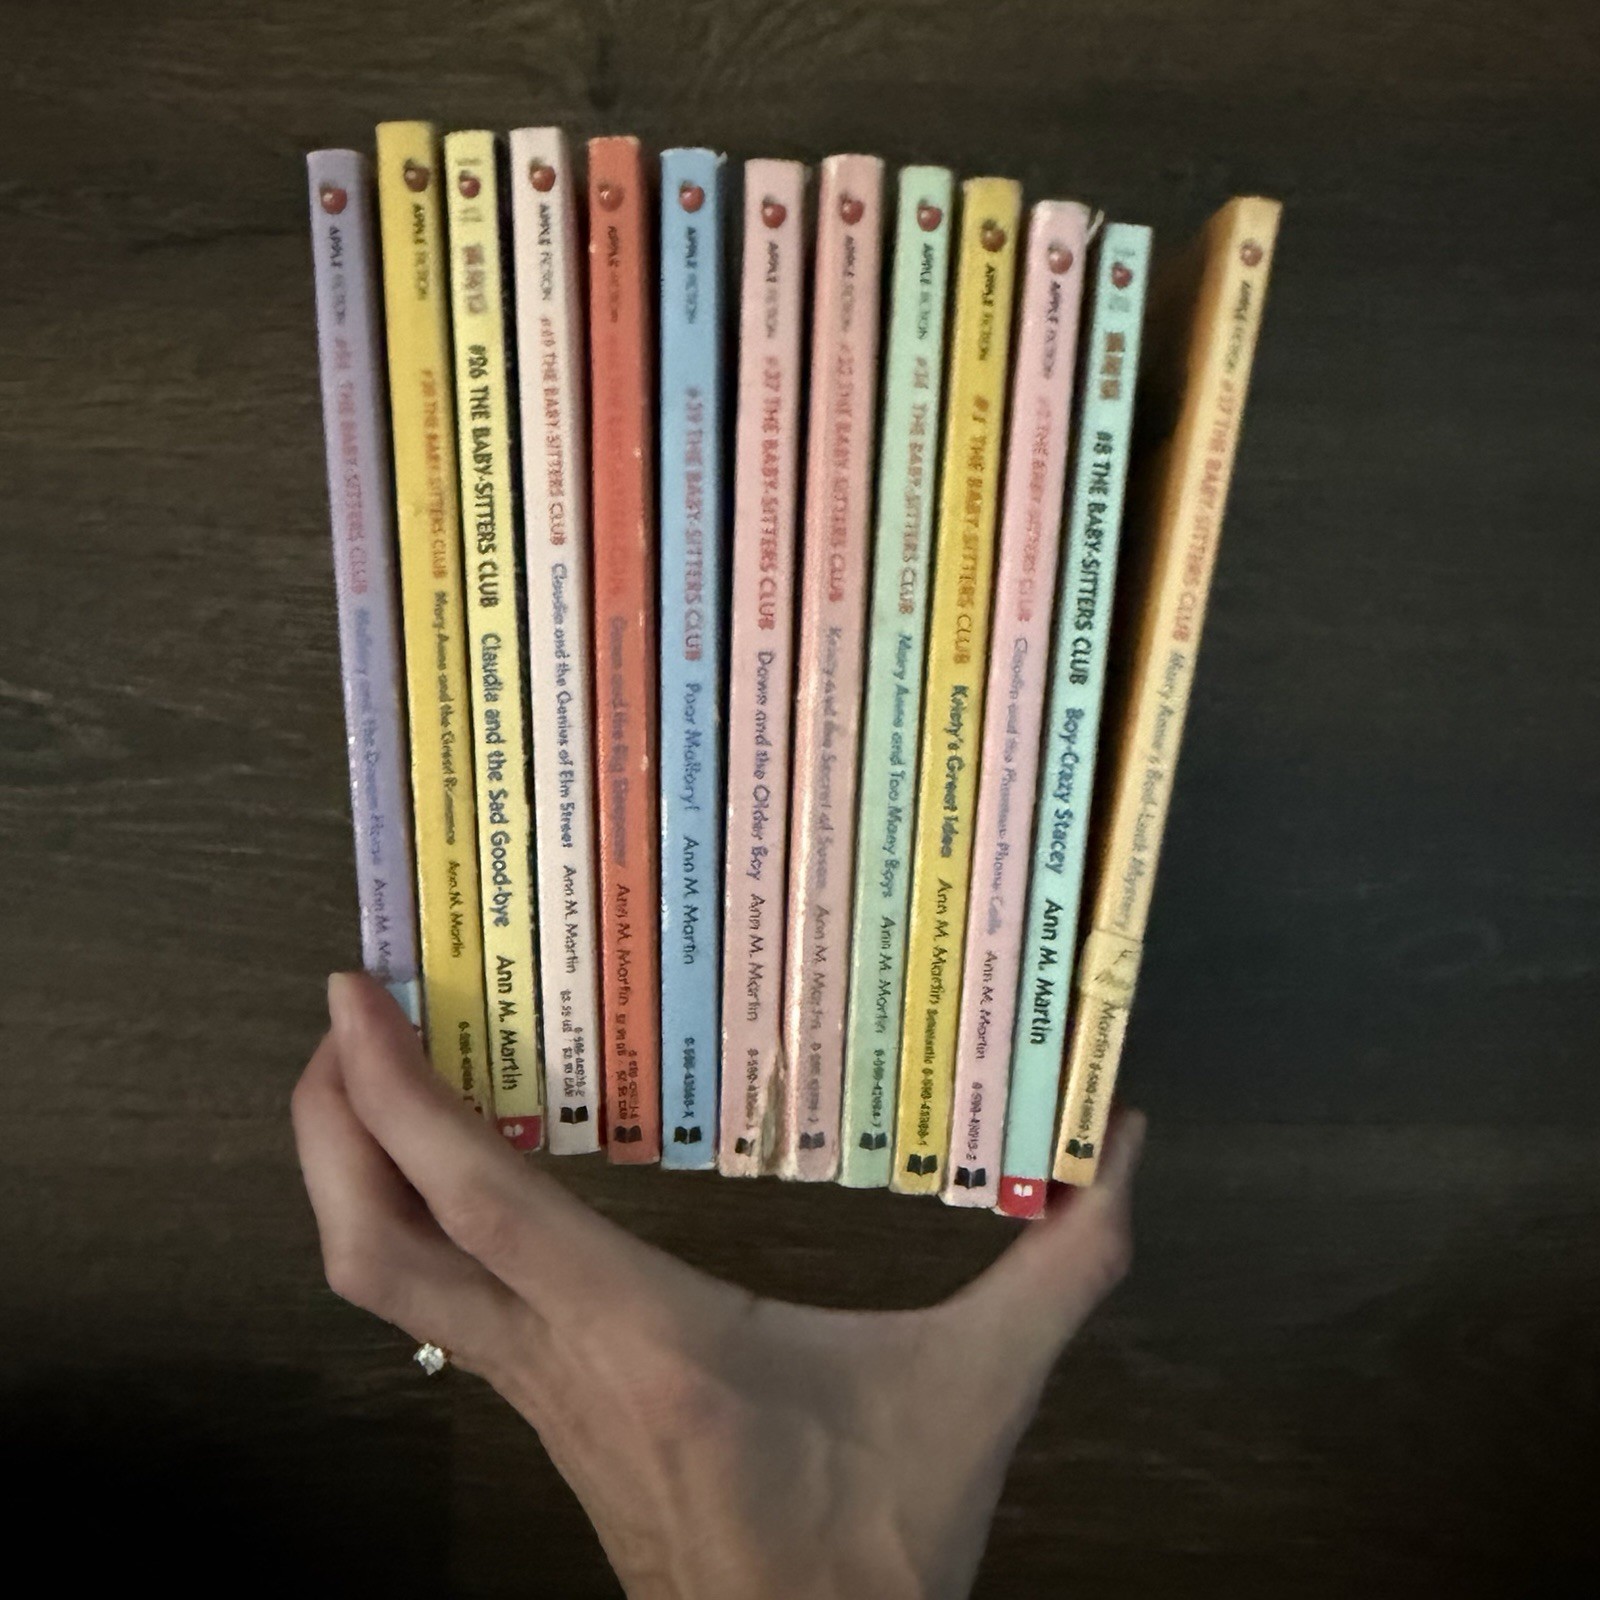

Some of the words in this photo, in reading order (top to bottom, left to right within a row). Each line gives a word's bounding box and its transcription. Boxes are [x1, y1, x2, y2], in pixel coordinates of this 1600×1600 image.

[980, 262, 997, 307] APPLE
[541, 352, 557, 381] THE
[468, 385, 491, 419] THE
[761, 396, 780, 433] THE
[967, 434, 987, 470] THE
[470, 426, 497, 554] BABY-SITTERS
[1087, 459, 1110, 496] THE
[548, 502, 566, 546] CLUB
[476, 559, 499, 608] CLUB
[1073, 500, 1107, 632] BABY-SITTERS
[757, 576, 776, 631] CLUB
[898, 566, 918, 615] CLUB
[554, 628, 570, 659] and
[684, 608, 702, 660] CLUB
[892, 632, 912, 680] Mary
[952, 612, 973, 665] CLUB
[480, 632, 504, 702] Claudia
[555, 663, 570, 686] the
[1068, 635, 1092, 686] CLUB
[684, 681, 701, 725] Poor
[483, 708, 506, 744] and
[754, 709, 772, 745] and
[485, 750, 508, 781] the
[558, 749, 573, 766] of
[888, 732, 907, 766] and
[1051, 705, 1085, 804] Boy-Crazy
[558, 769, 575, 798] Elm
[887, 769, 905, 801] Too
[487, 788, 510, 824] Sad
[559, 802, 576, 848] Street
[751, 784, 770, 841] Older
[881, 805, 903, 855] Many
[1044, 807, 1074, 875] Stacey
[683, 835, 699, 871] Ann
[746, 845, 768, 880] Boy
[486, 830, 514, 928] Good-bye
[562, 864, 577, 896] Ann
[878, 858, 900, 899] Boys
[933, 877, 953, 915] Ann
[748, 893, 765, 930] Ann
[813, 904, 830, 939] Ann
[878, 915, 896, 949] Ann
[932, 918, 949, 942] M.
[1040, 897, 1064, 941] Ann
[449, 912, 465, 958] Martin
[563, 922, 580, 973] Martin
[682, 904, 698, 964] Martin
[748, 934, 764, 958] M.
[494, 954, 516, 993] Ann
[616, 948, 632, 1006] Martin
[926, 946, 947, 1005] Martin
[982, 950, 997, 982] Ann
[1037, 946, 1058, 972] M.
[497, 999, 516, 1022] M.
[745, 962, 763, 1022] Martin
[873, 978, 891, 1034] Martin
[1028, 976, 1057, 1047] Martin
[974, 1008, 993, 1060] Martin
[1092, 1000, 1117, 1060] Martin
[498, 1028, 523, 1090] Martin
